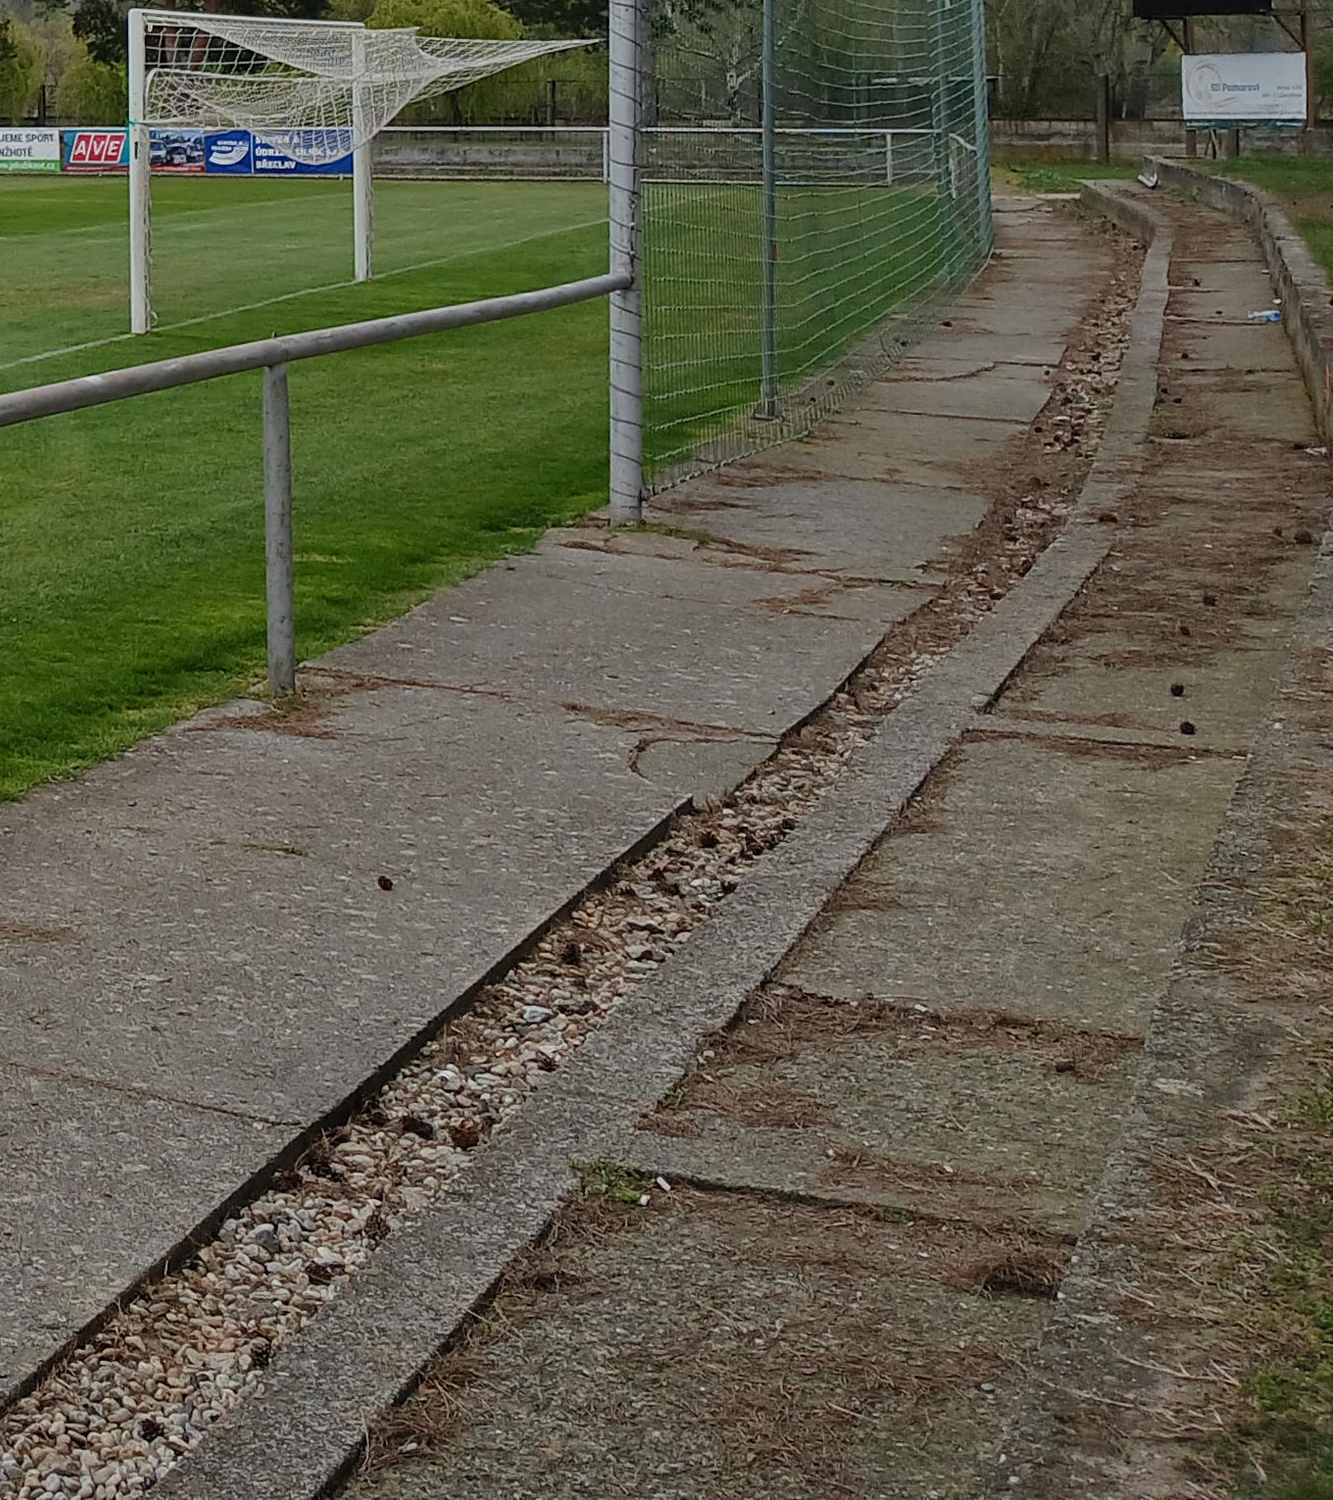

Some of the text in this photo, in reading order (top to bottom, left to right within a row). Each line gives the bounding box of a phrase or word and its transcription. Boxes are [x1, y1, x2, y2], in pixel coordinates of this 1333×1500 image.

[25, 133, 54, 143] SPORT
[74, 140, 121, 156] AVE
[255, 159, 297, 170] BŘECLAV
